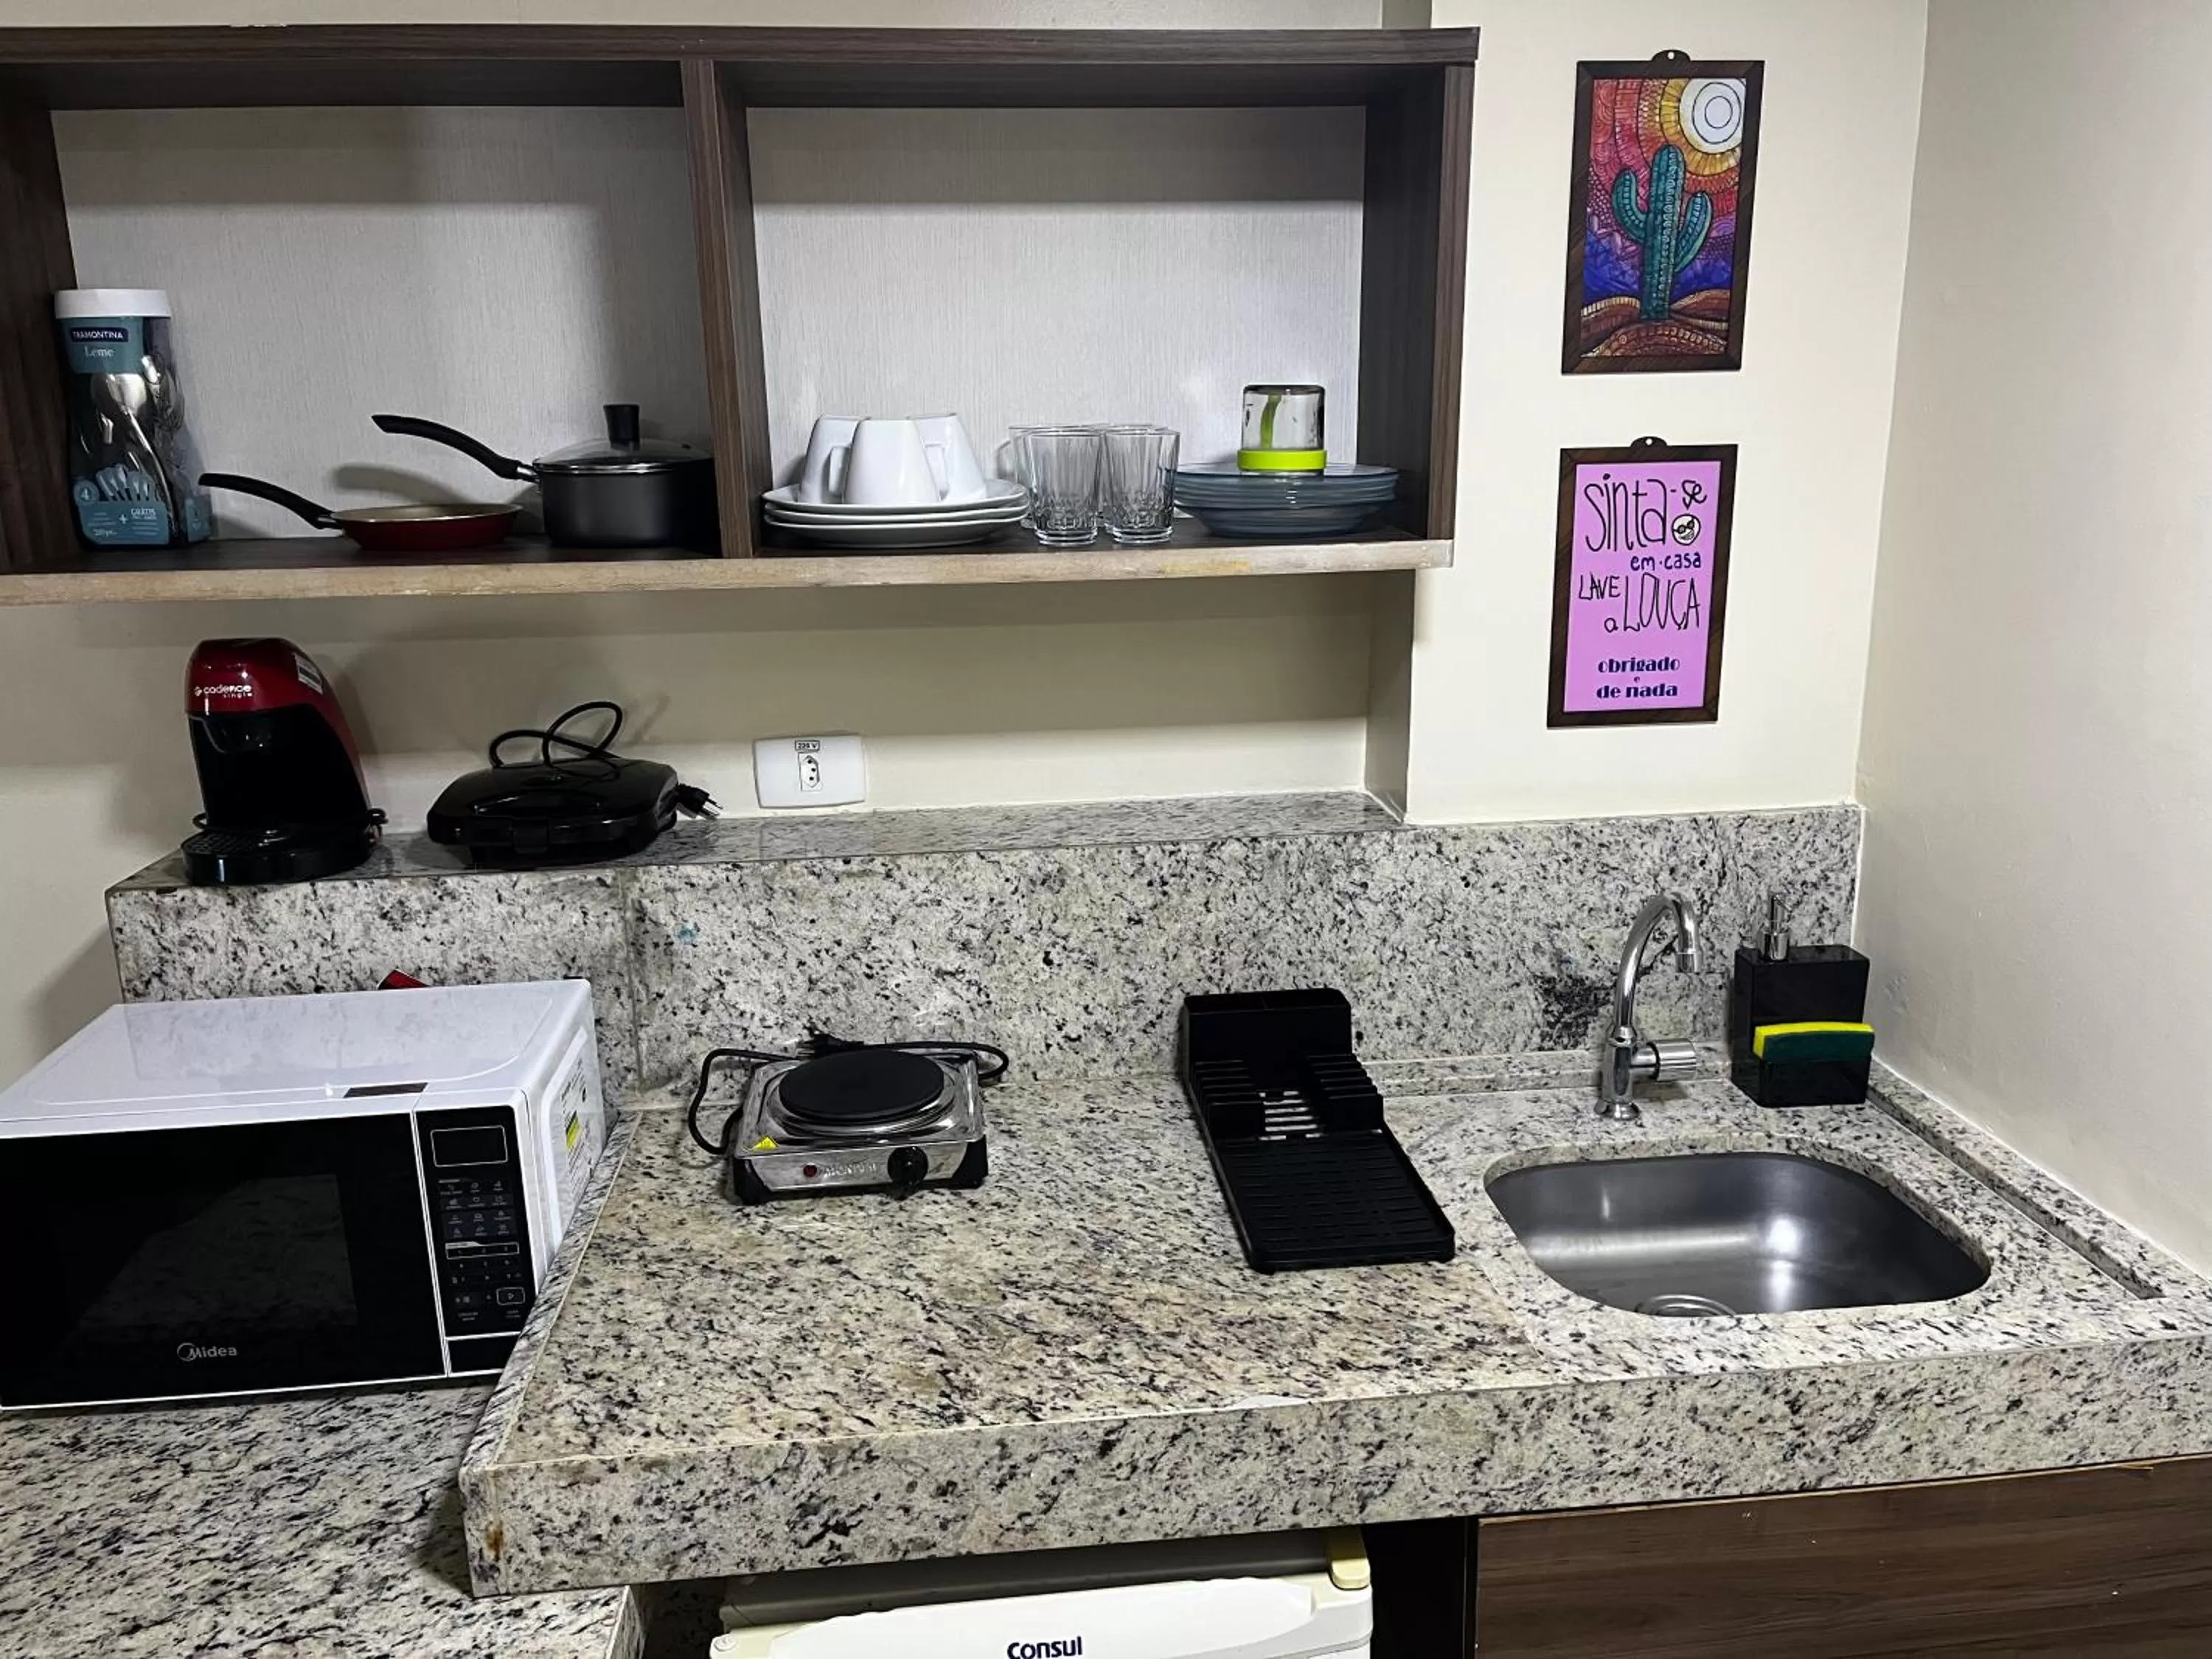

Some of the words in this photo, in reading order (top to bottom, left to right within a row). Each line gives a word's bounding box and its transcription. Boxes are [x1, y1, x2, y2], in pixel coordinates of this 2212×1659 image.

[72, 330, 123, 340] TRAMONTINA
[1630, 555, 1655, 571] em
[1664, 552, 1701, 569] casa
[1579, 573, 1621, 600] LAVE
[1598, 656, 1680, 673] obrigado
[204, 685, 251, 694] cadence
[1596, 685, 1621, 698] de
[1626, 684, 1678, 698] nada
[184, 1344, 237, 1358] Midea
[1007, 1636, 1082, 1659] Consul
